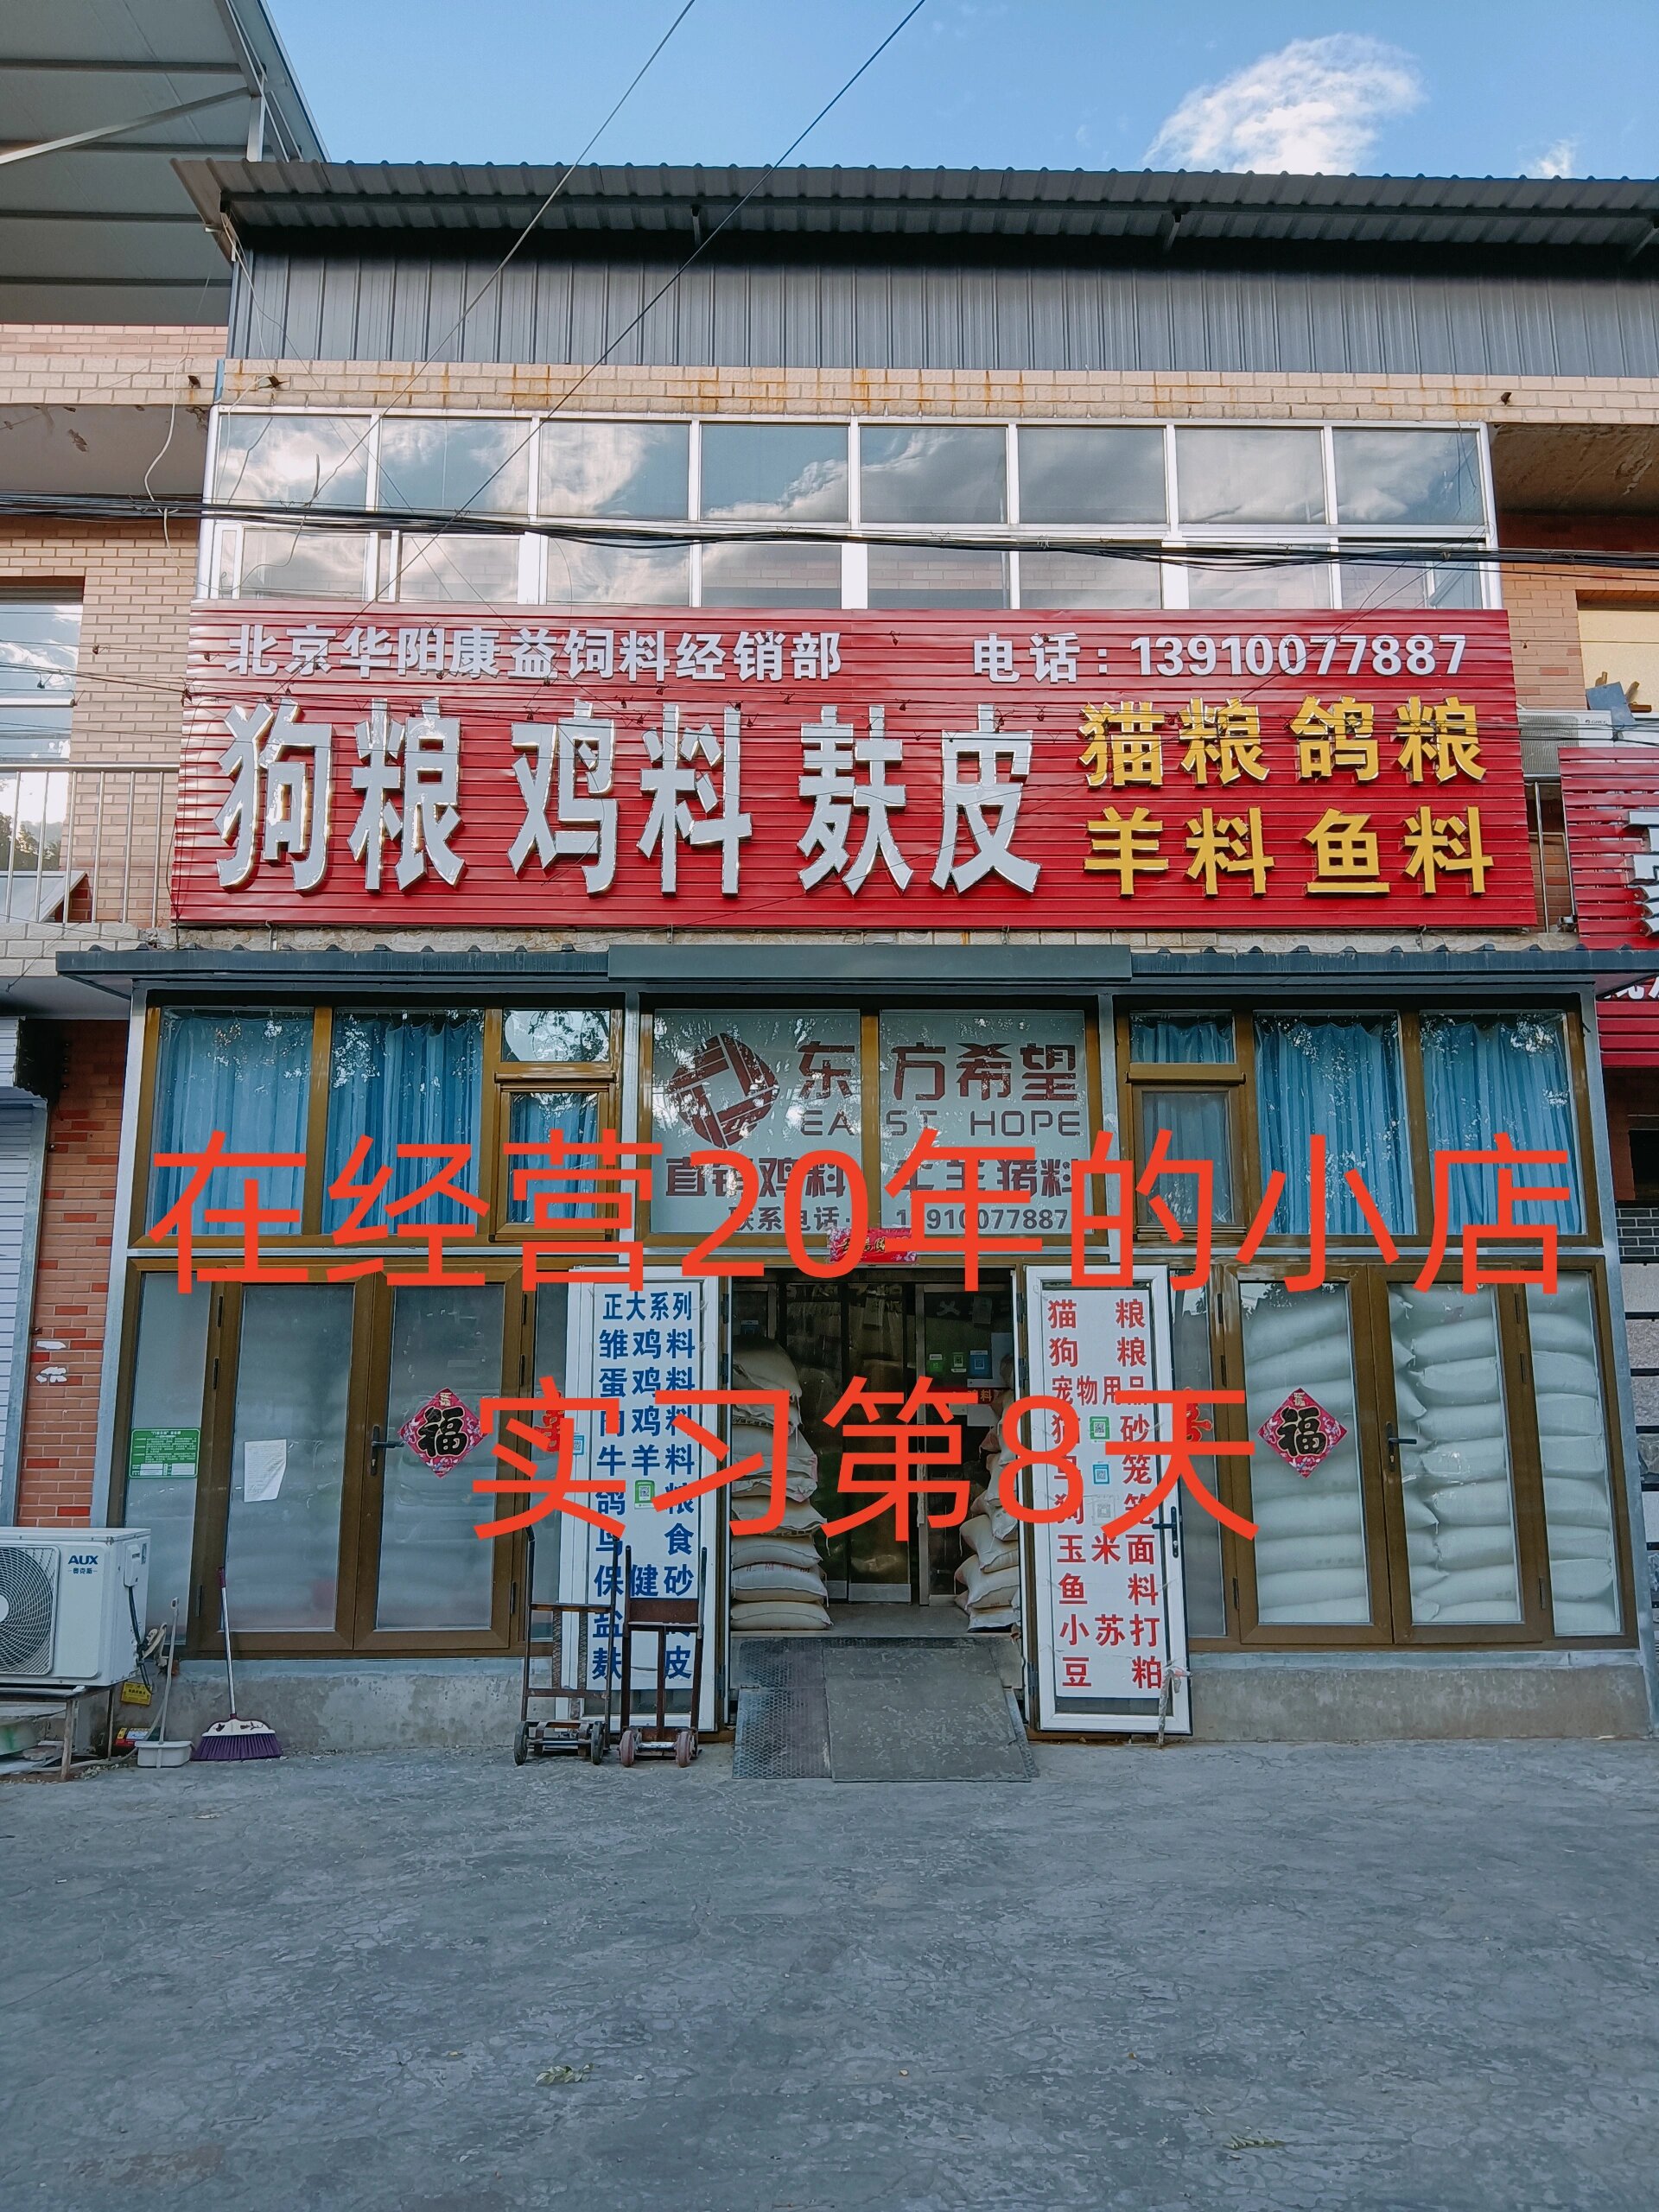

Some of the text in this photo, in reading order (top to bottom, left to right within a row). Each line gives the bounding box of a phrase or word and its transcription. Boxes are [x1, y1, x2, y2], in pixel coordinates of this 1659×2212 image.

[225, 624, 842, 683] 北京华阳康益饲料经销部
[969, 1109, 1080, 1137] HOPE
[602, 1290, 693, 1323] 正大系列
[599, 1328, 696, 1361] 雏鸡料
[416, 1405, 469, 1458] 福
[1276, 1405, 1328, 1458] 福
[596, 1444, 696, 1477] 牛羊料
[67, 1554, 99, 1565] AUX
[1057, 1534, 1155, 1566] 玉米面
[594, 1563, 695, 1598] 保健砂
[1058, 1573, 1159, 1606] 鱼料
[1059, 1613, 1160, 1647] 小苏打
